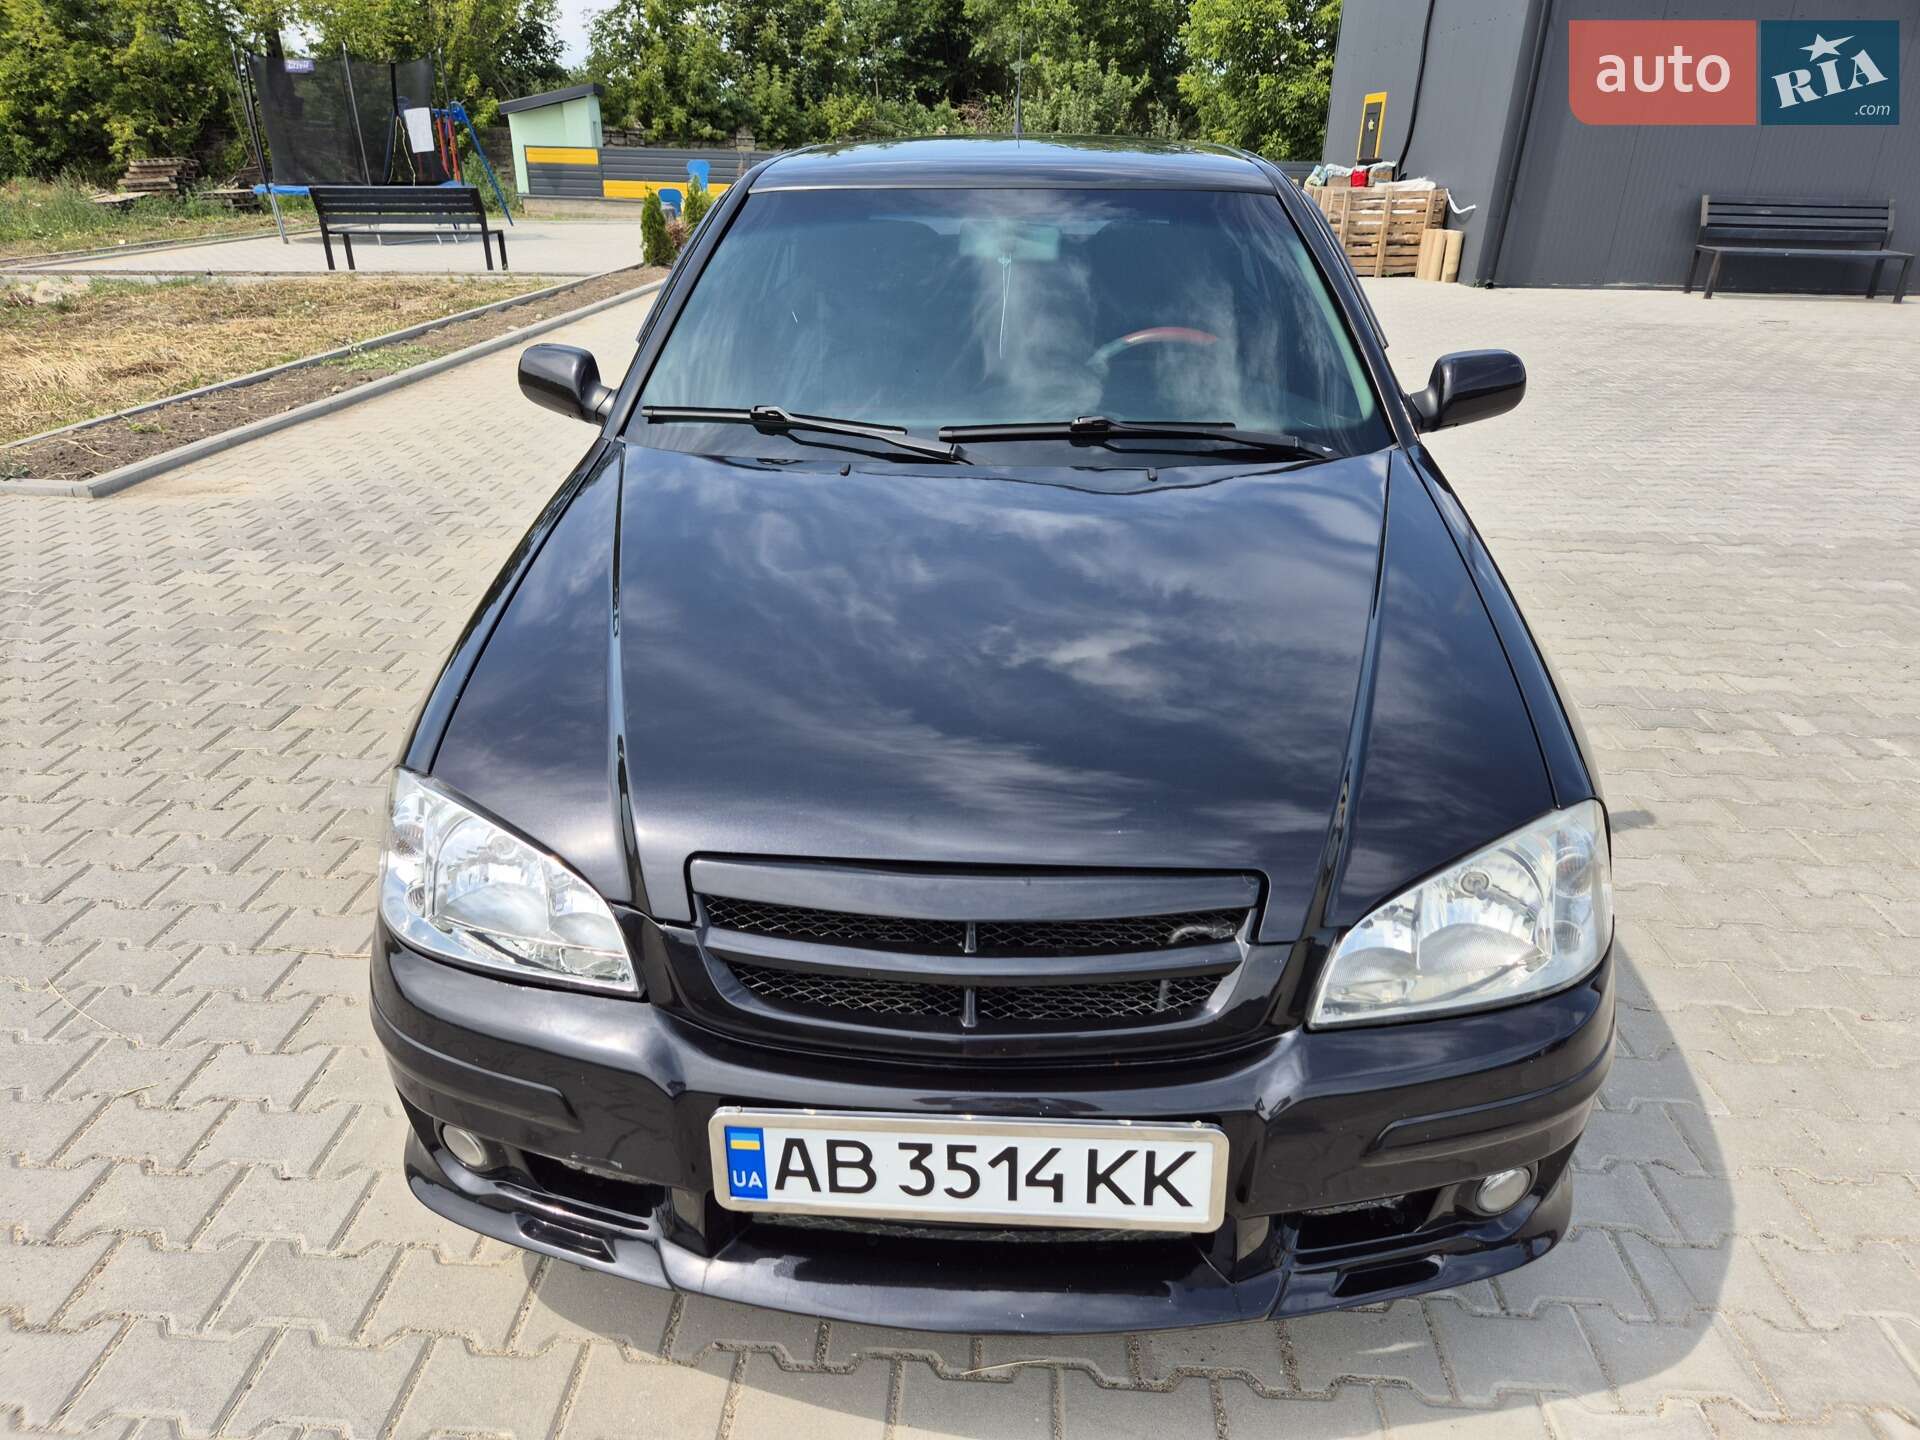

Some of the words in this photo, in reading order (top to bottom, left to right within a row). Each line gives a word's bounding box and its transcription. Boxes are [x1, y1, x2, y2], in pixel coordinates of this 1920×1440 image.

[732, 1169, 764, 1188] UA
[774, 1137, 878, 1194] AB
[898, 1142, 1064, 1204] 3514
[1086, 1148, 1197, 1208] KK
